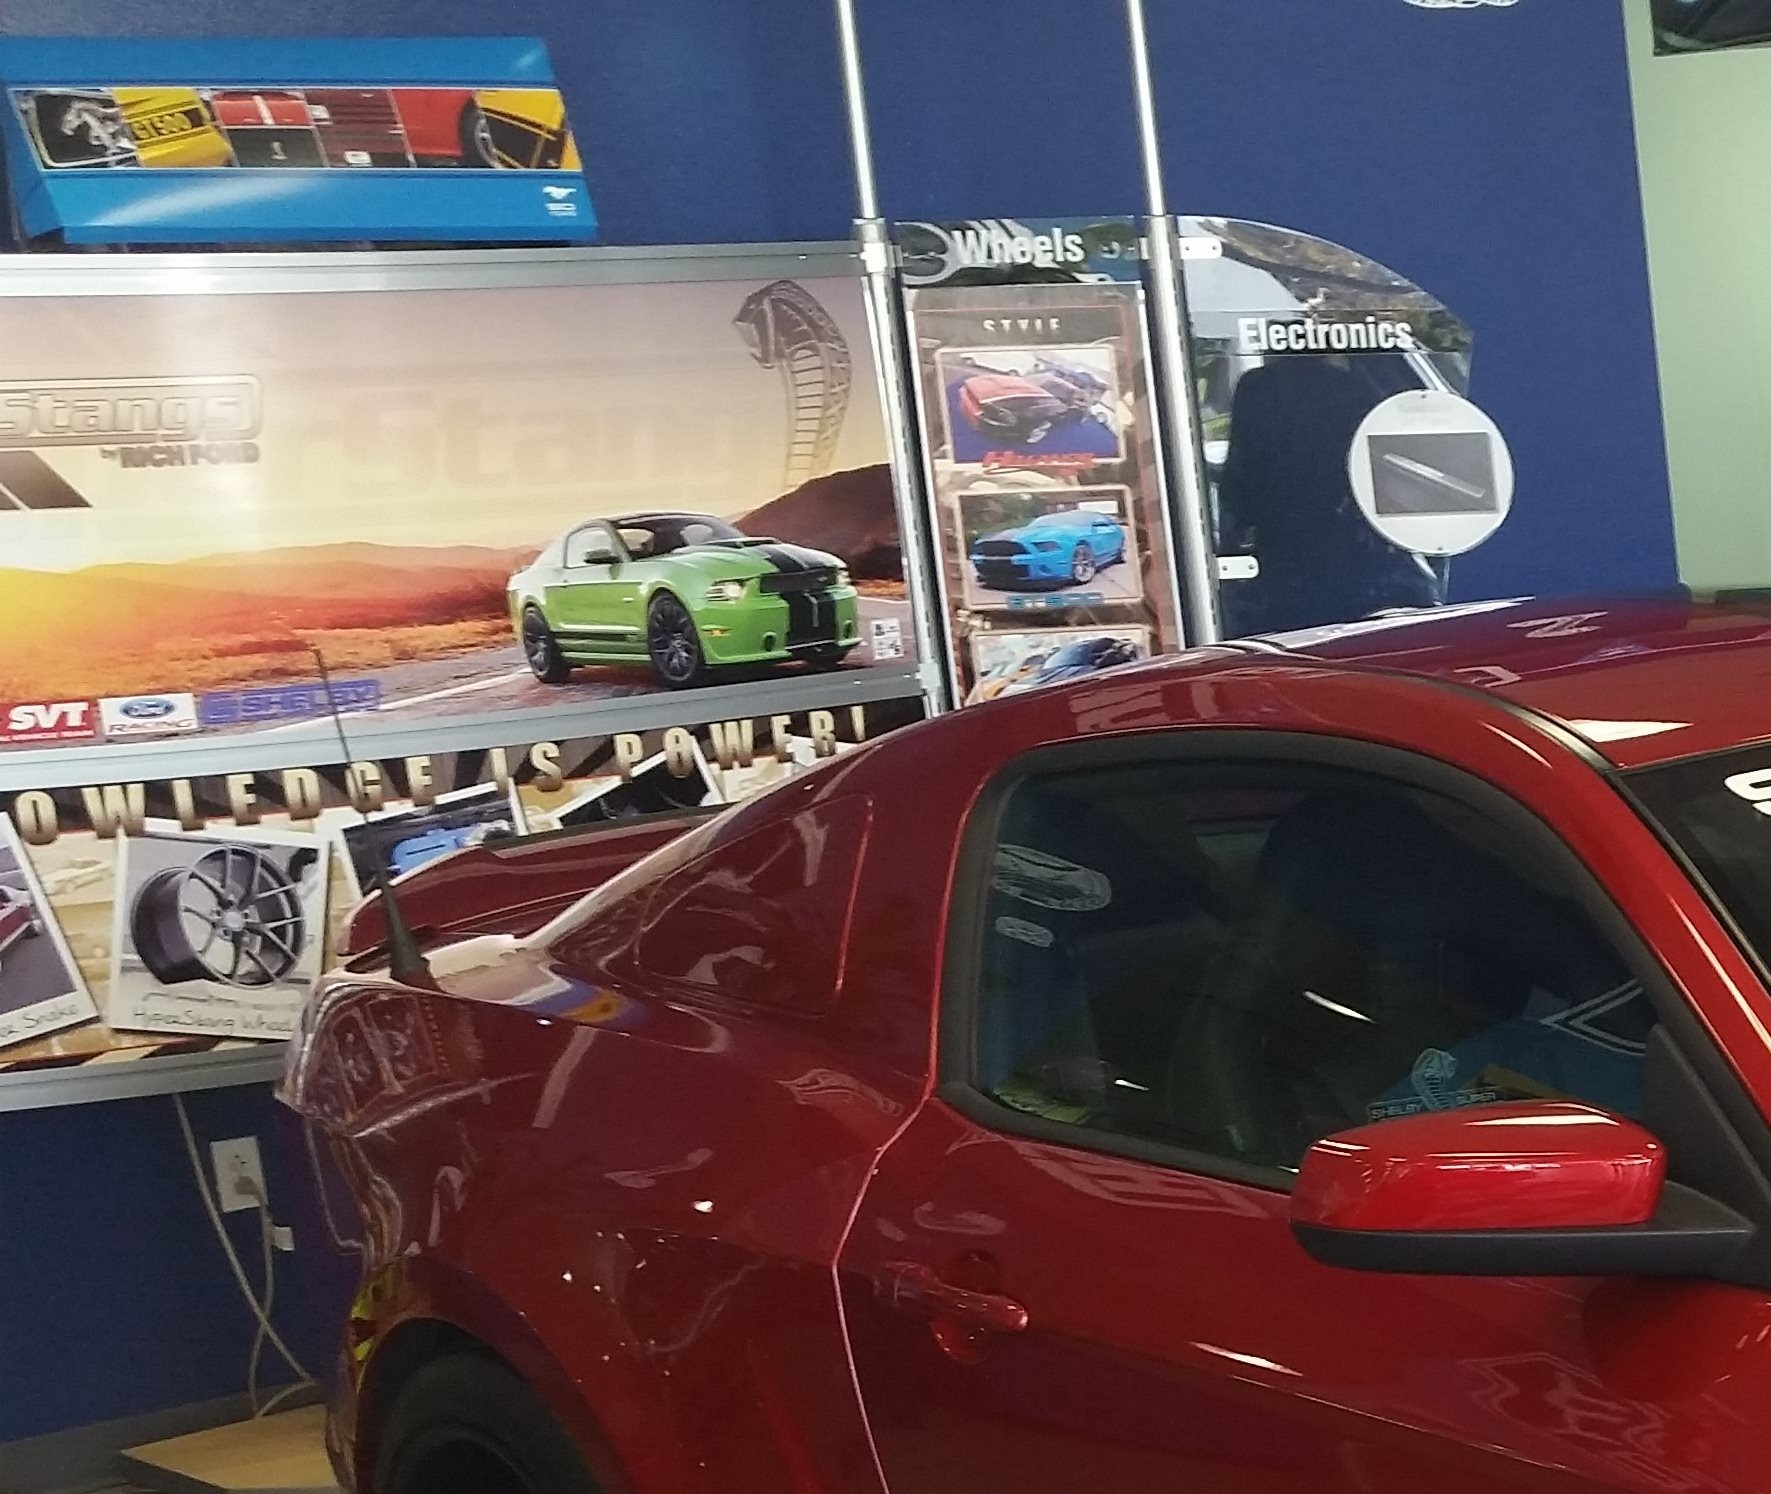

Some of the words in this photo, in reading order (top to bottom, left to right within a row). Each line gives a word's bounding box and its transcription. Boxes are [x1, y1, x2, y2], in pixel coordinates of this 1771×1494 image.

[952, 227, 1085, 266] Wheels
[1237, 316, 1416, 352] Electronics
[7, 701, 91, 730] SVT
[489, 741, 563, 797] IS
[614, 705, 867, 782] POWER!
